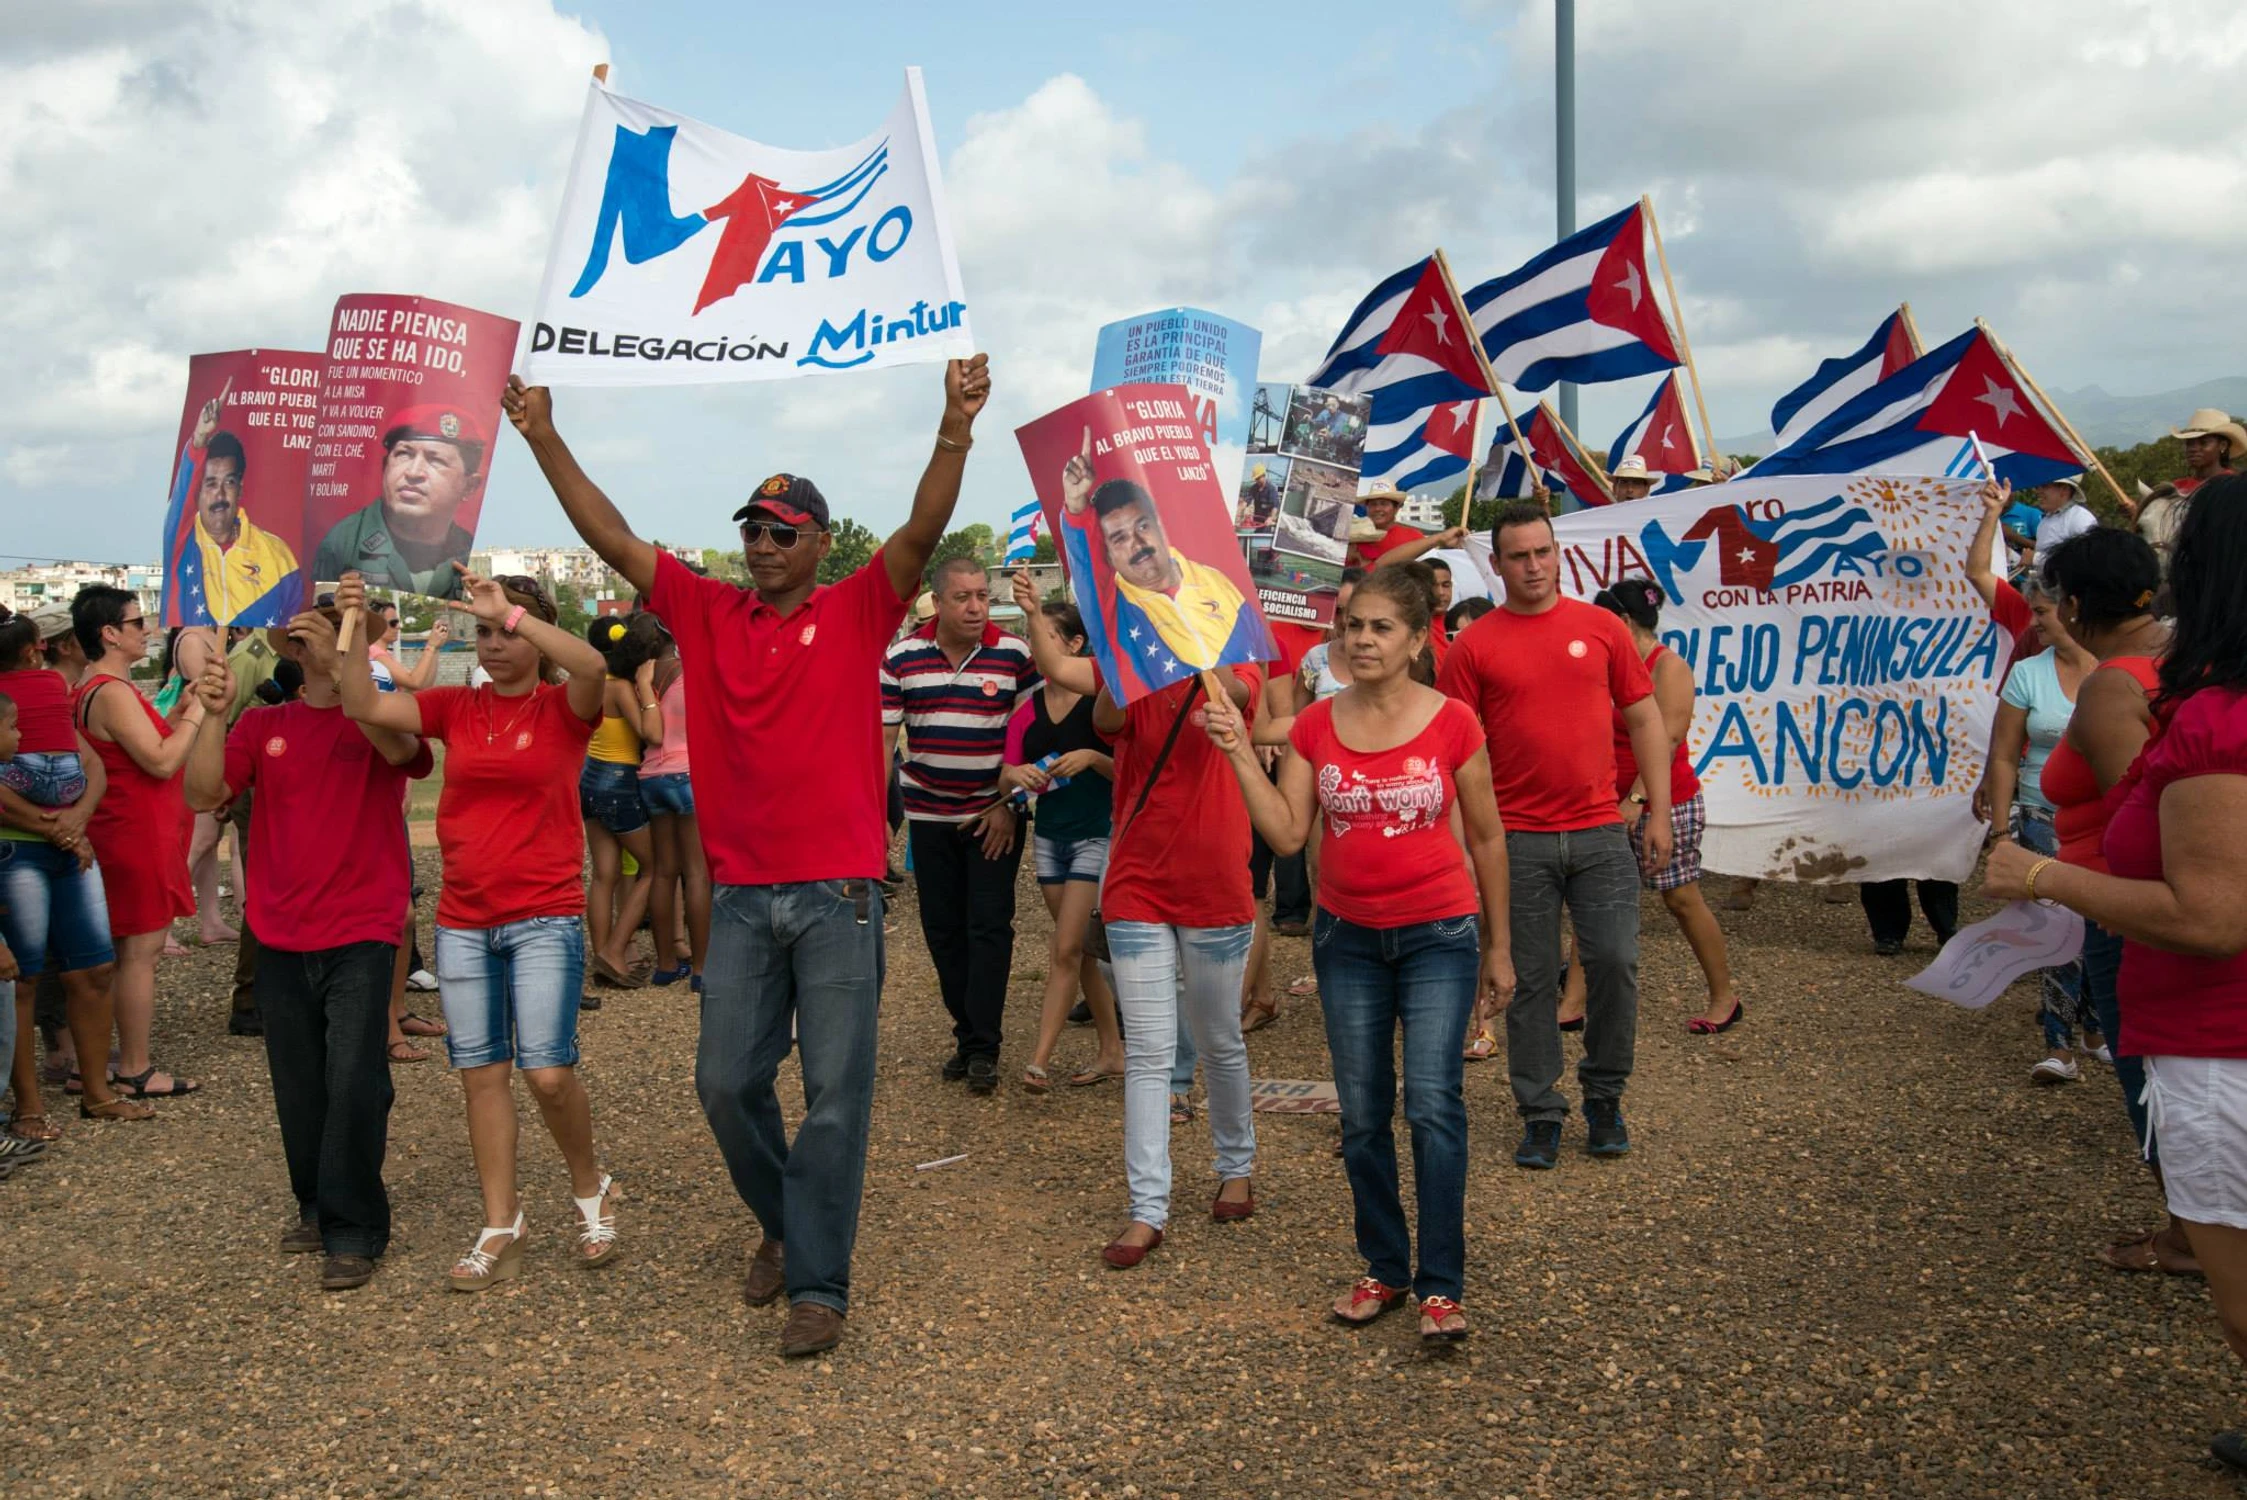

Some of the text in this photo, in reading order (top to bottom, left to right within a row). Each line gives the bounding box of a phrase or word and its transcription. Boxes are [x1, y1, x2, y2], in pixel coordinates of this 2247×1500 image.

[338, 309, 467, 346] NADIE PIENSA
[798, 300, 967, 366] Mintur
[1128, 318, 1228, 340] UN PUEBLO UNIDO
[1126, 331, 1228, 356] ES LA PRINCIPAL
[333, 338, 466, 378] QUE SE HA IDO,
[1125, 343, 1227, 370] GARANTÍA DE QUE
[261, 366, 321, 388] “GLORI
[328, 366, 423, 385] FUE UN MOMENTICO
[1123, 361, 1226, 384] SIEMPRE PODREMOS
[324, 385, 365, 398] A LA MISA
[1155, 374, 1167, 383] EN
[1170, 374, 1192, 386] ESTA
[1195, 377, 1224, 396] TIERRA
[227, 391, 317, 408] AL BRAVO PUEBL
[248, 412, 316, 429] QUE EL YUG
[322, 404, 384, 419] Y VA A VOLVER
[283, 434, 312, 449] LANZ
[318, 424, 378, 440] CON SANDINO,
[1095, 424, 1193, 456] AL BRAVO PUEBLO
[315, 444, 331, 457] CON
[333, 444, 342, 457] EL
[1133, 445, 1200, 465] QUE EL YUGO
[312, 461, 336, 476] MARTÍ
[310, 481, 348, 496] Y BOLÍVAR
[1556, 535, 1655, 595] IVA
[1258, 588, 1307, 606] EFICIENCIA
[1703, 580, 1873, 609] CON LA PATRIA
[1263, 602, 1317, 620] SOCIALISMO
[1793, 614, 1999, 686] PENINSULA
[1695, 695, 1949, 790] ANCON
[1319, 786, 1371, 812] Don't
